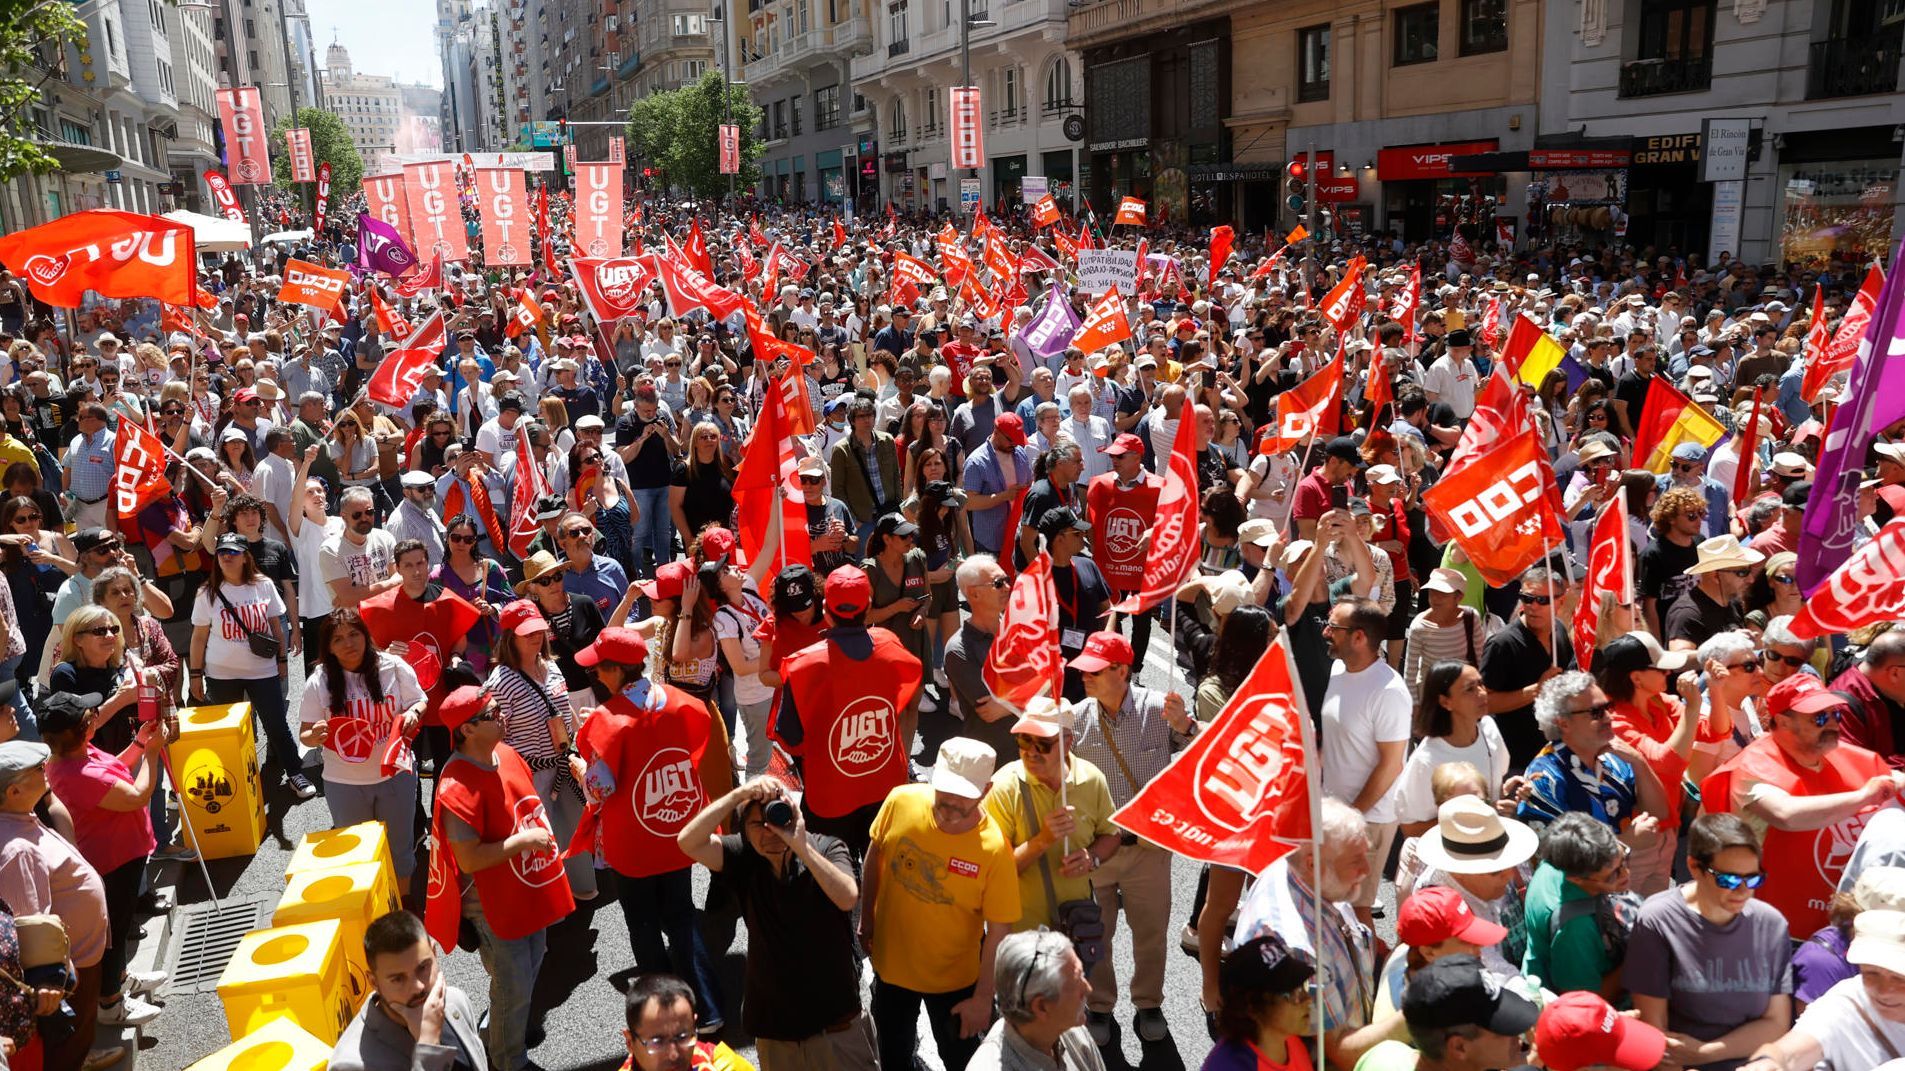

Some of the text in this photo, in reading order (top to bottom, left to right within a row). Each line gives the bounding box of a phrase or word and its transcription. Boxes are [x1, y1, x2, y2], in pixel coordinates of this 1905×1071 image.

[227, 90, 254, 157] UGT
[960, 91, 977, 165] CCOO
[1711, 128, 1719, 139] El
[1090, 137, 1149, 152] SALVADOR BACHILLER
[1708, 147, 1716, 157] de
[1717, 147, 1733, 157] Gran
[1634, 149, 1684, 164] GRAN
[1319, 185, 1354, 194] VIPS
[375, 178, 400, 235] UG
[417, 164, 447, 239] UGT
[490, 170, 513, 243] UGT
[589, 166, 610, 238] UGT
[898, 258, 937, 283] CCOO
[1080, 256, 1133, 268] COMPATIBILIDAD
[599, 265, 641, 288] UGT
[1106, 517, 1141, 540] UGT
[1120, 564, 1143, 572] mano
[905, 578, 920, 587] UGT
[840, 707, 889, 748] UGT
[1204, 702, 1294, 822] UGT
[645, 761, 695, 803] UGT
[950, 859, 979, 873] CCOO
